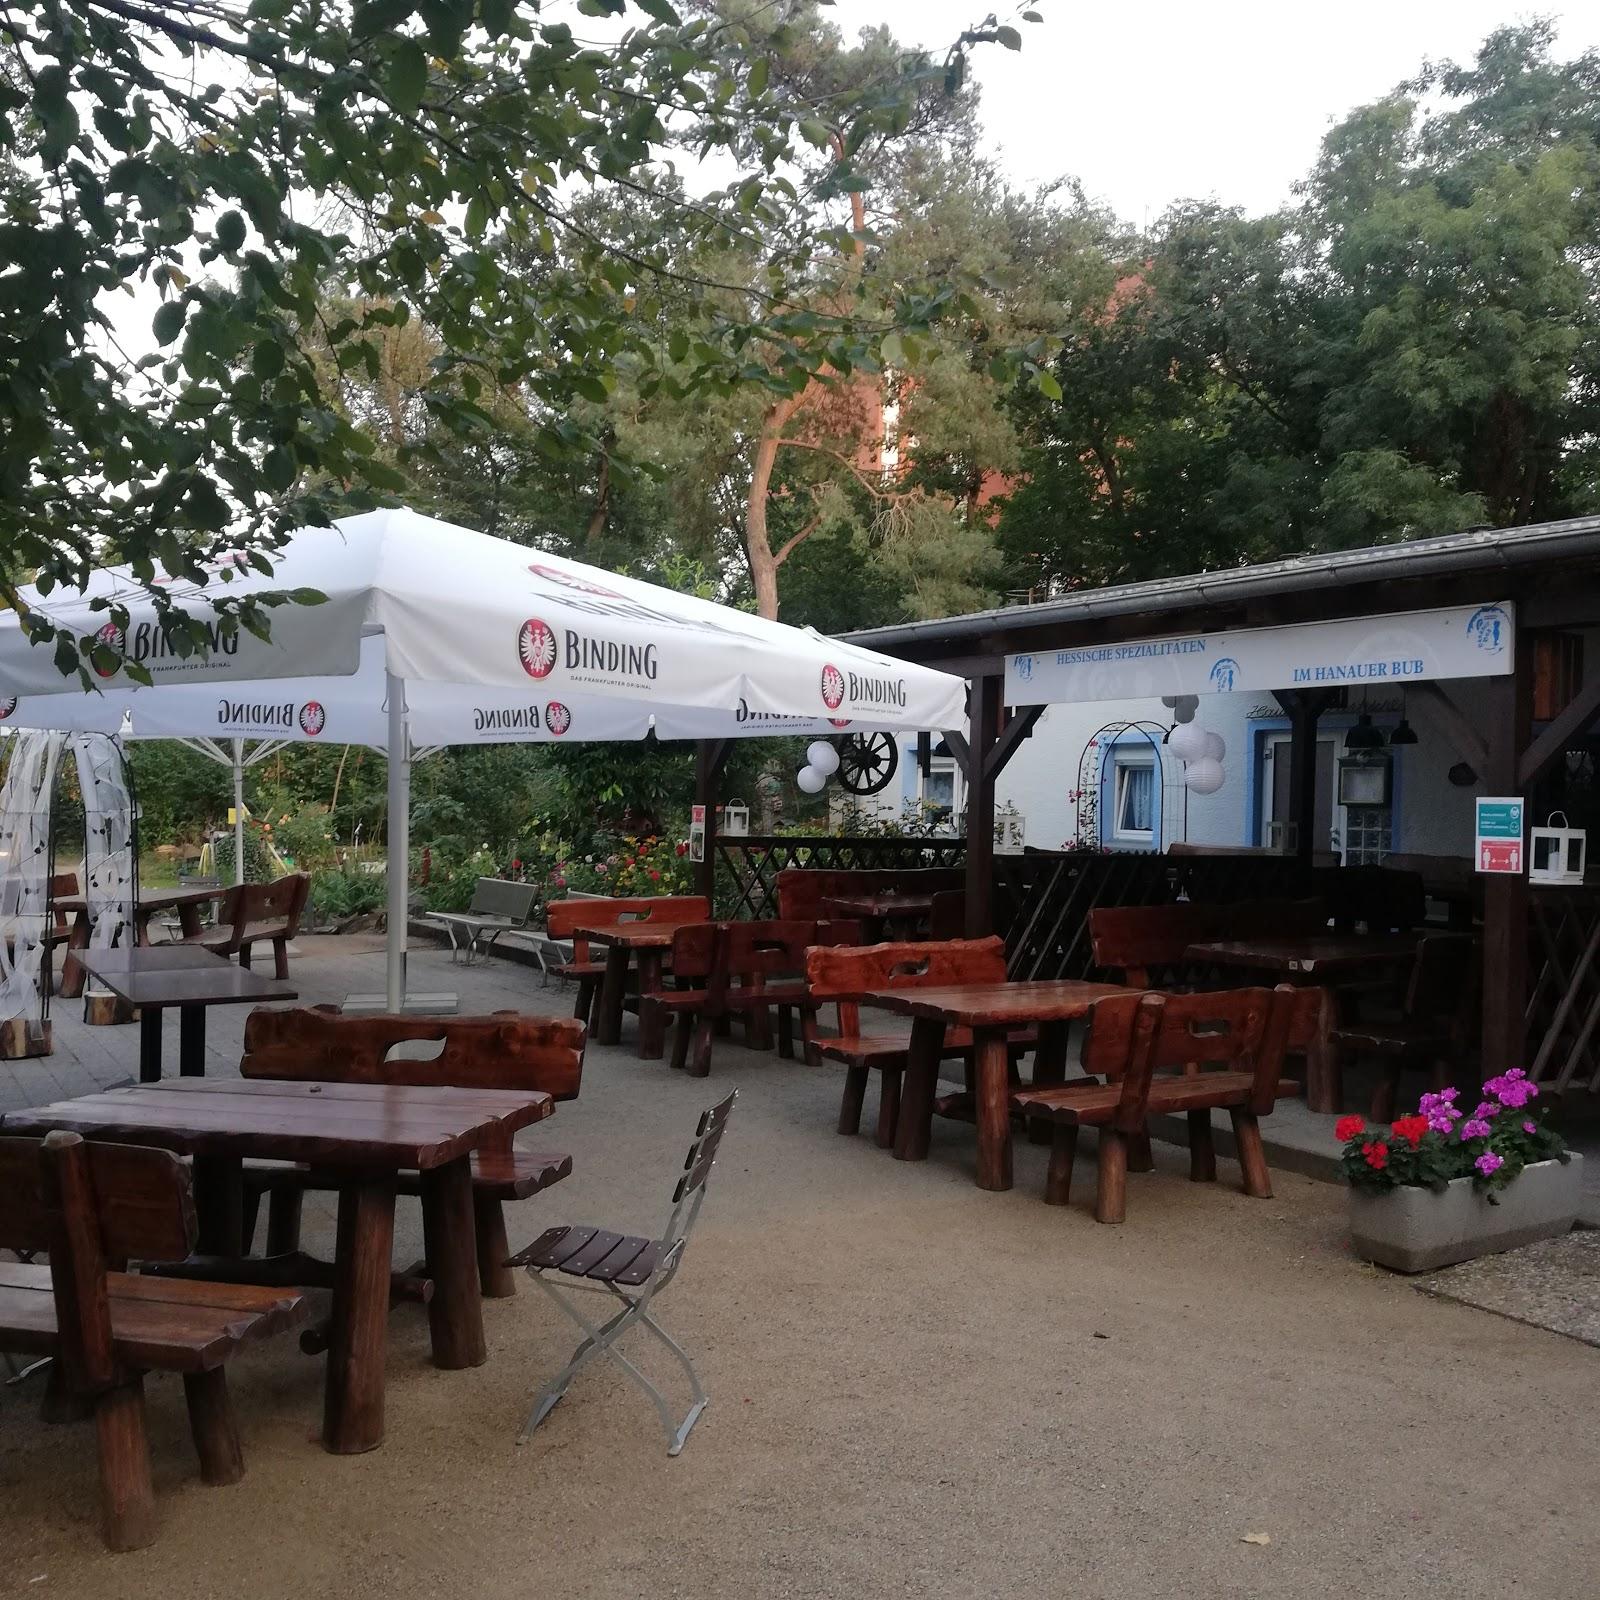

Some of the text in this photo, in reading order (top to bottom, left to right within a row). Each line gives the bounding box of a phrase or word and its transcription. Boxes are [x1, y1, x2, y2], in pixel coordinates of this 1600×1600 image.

[565, 629, 657, 680] BINDING
[1057, 651, 1113, 665] HESSISCHE
[1293, 660, 1424, 682] IM HANAUER BUB
[848, 671, 906, 707] BINDING
